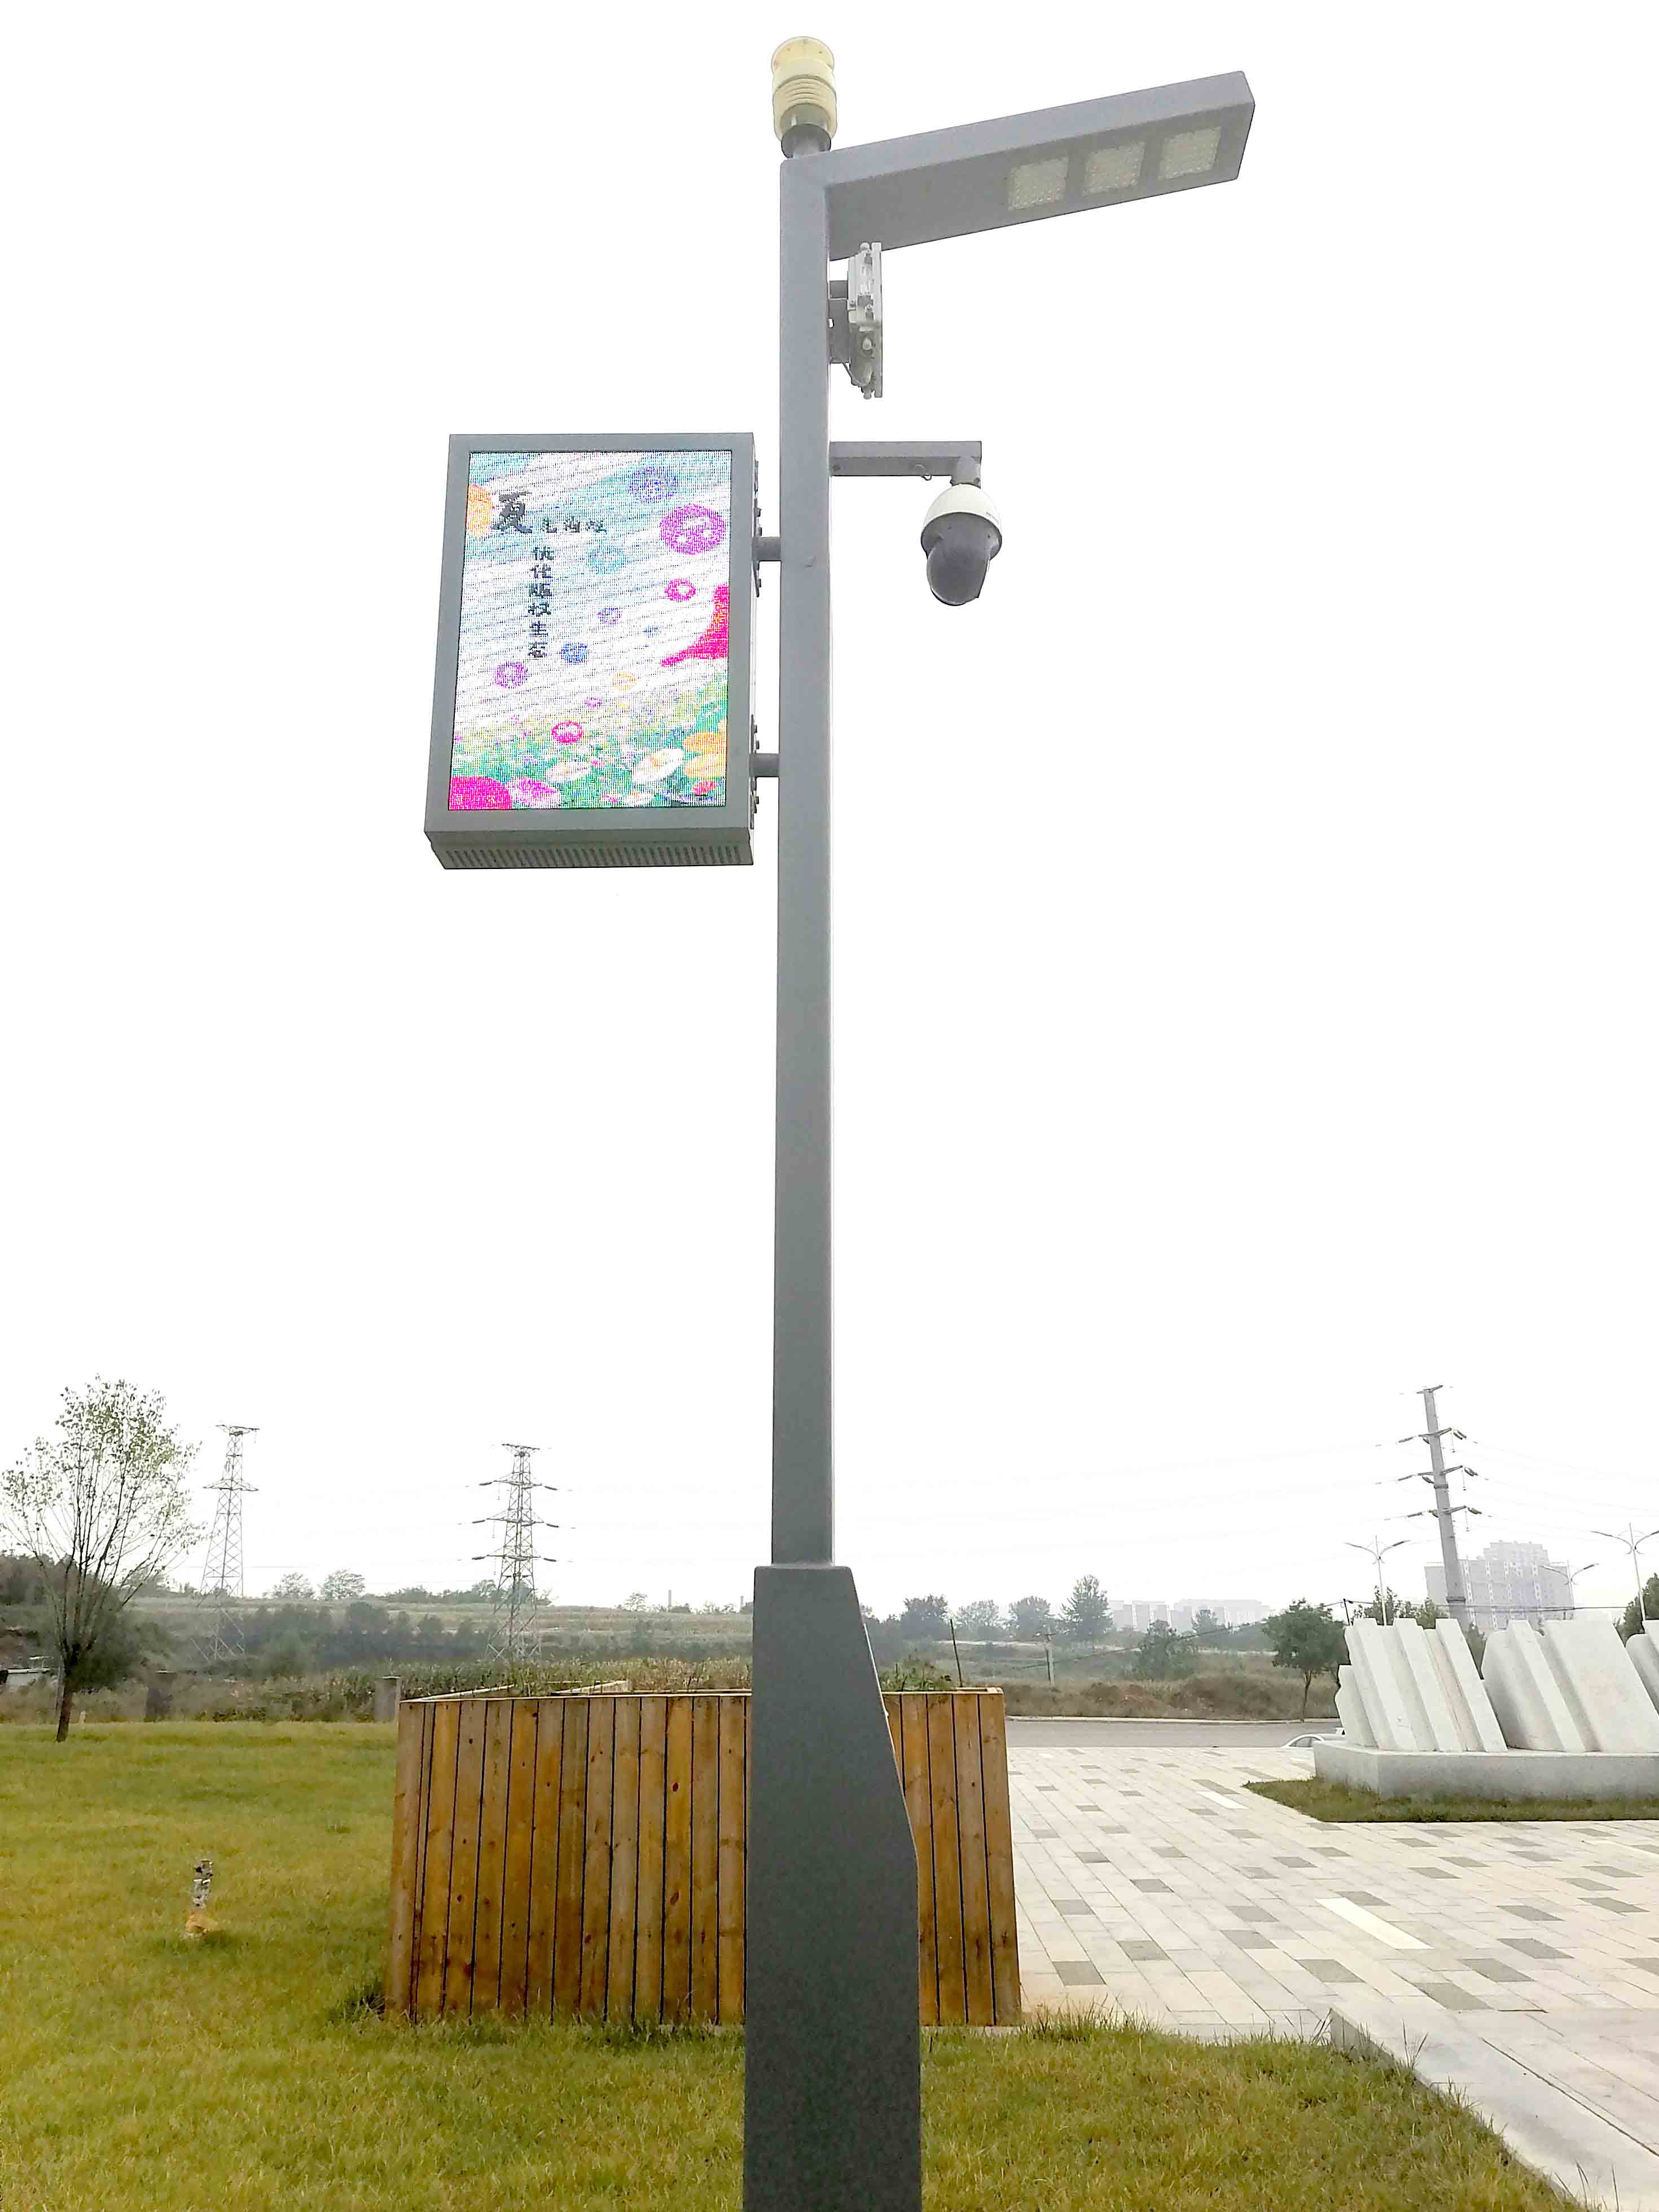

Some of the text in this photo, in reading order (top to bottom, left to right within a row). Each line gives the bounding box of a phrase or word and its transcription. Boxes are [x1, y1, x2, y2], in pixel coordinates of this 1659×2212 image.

[527, 546, 554, 659] 优化版权生态
